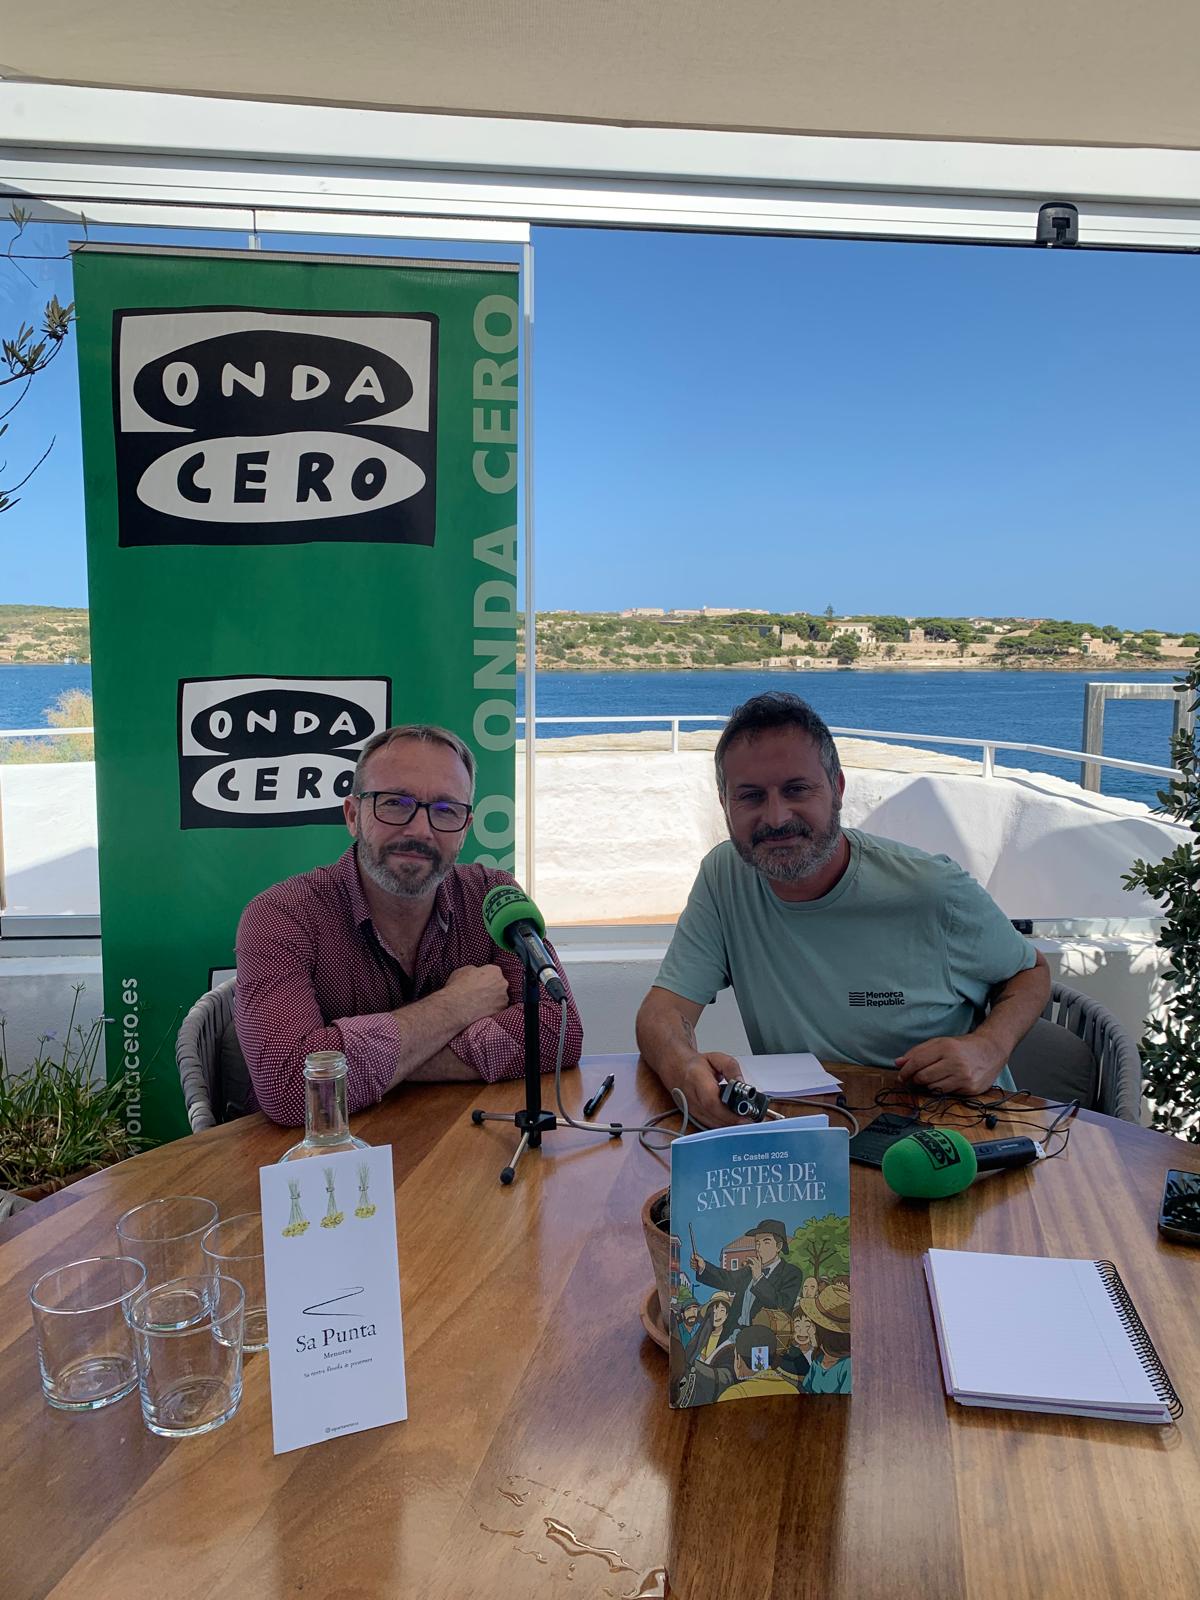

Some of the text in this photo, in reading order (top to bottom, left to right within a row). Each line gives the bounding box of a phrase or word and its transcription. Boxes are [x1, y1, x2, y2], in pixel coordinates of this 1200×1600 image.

[162, 360, 386, 406] ONDA
[472, 294, 519, 494] CERO
[176, 450, 387, 503] CERO
[472, 524, 518, 751] ONDA
[209, 709, 357, 739] ONDA
[217, 766, 355, 802] CERO
[865, 991, 904, 999] Menorca
[866, 998, 905, 1007] Republic
[122, 978, 142, 1135] ondacero.es
[732, 1151, 789, 1162] Es Castell 2025
[705, 1162, 817, 1190] FESTES DE
[697, 1182, 826, 1212] SANT JAUME
[295, 1323, 377, 1353] Sa Punta
[323, 1348, 352, 1359] Menorca
